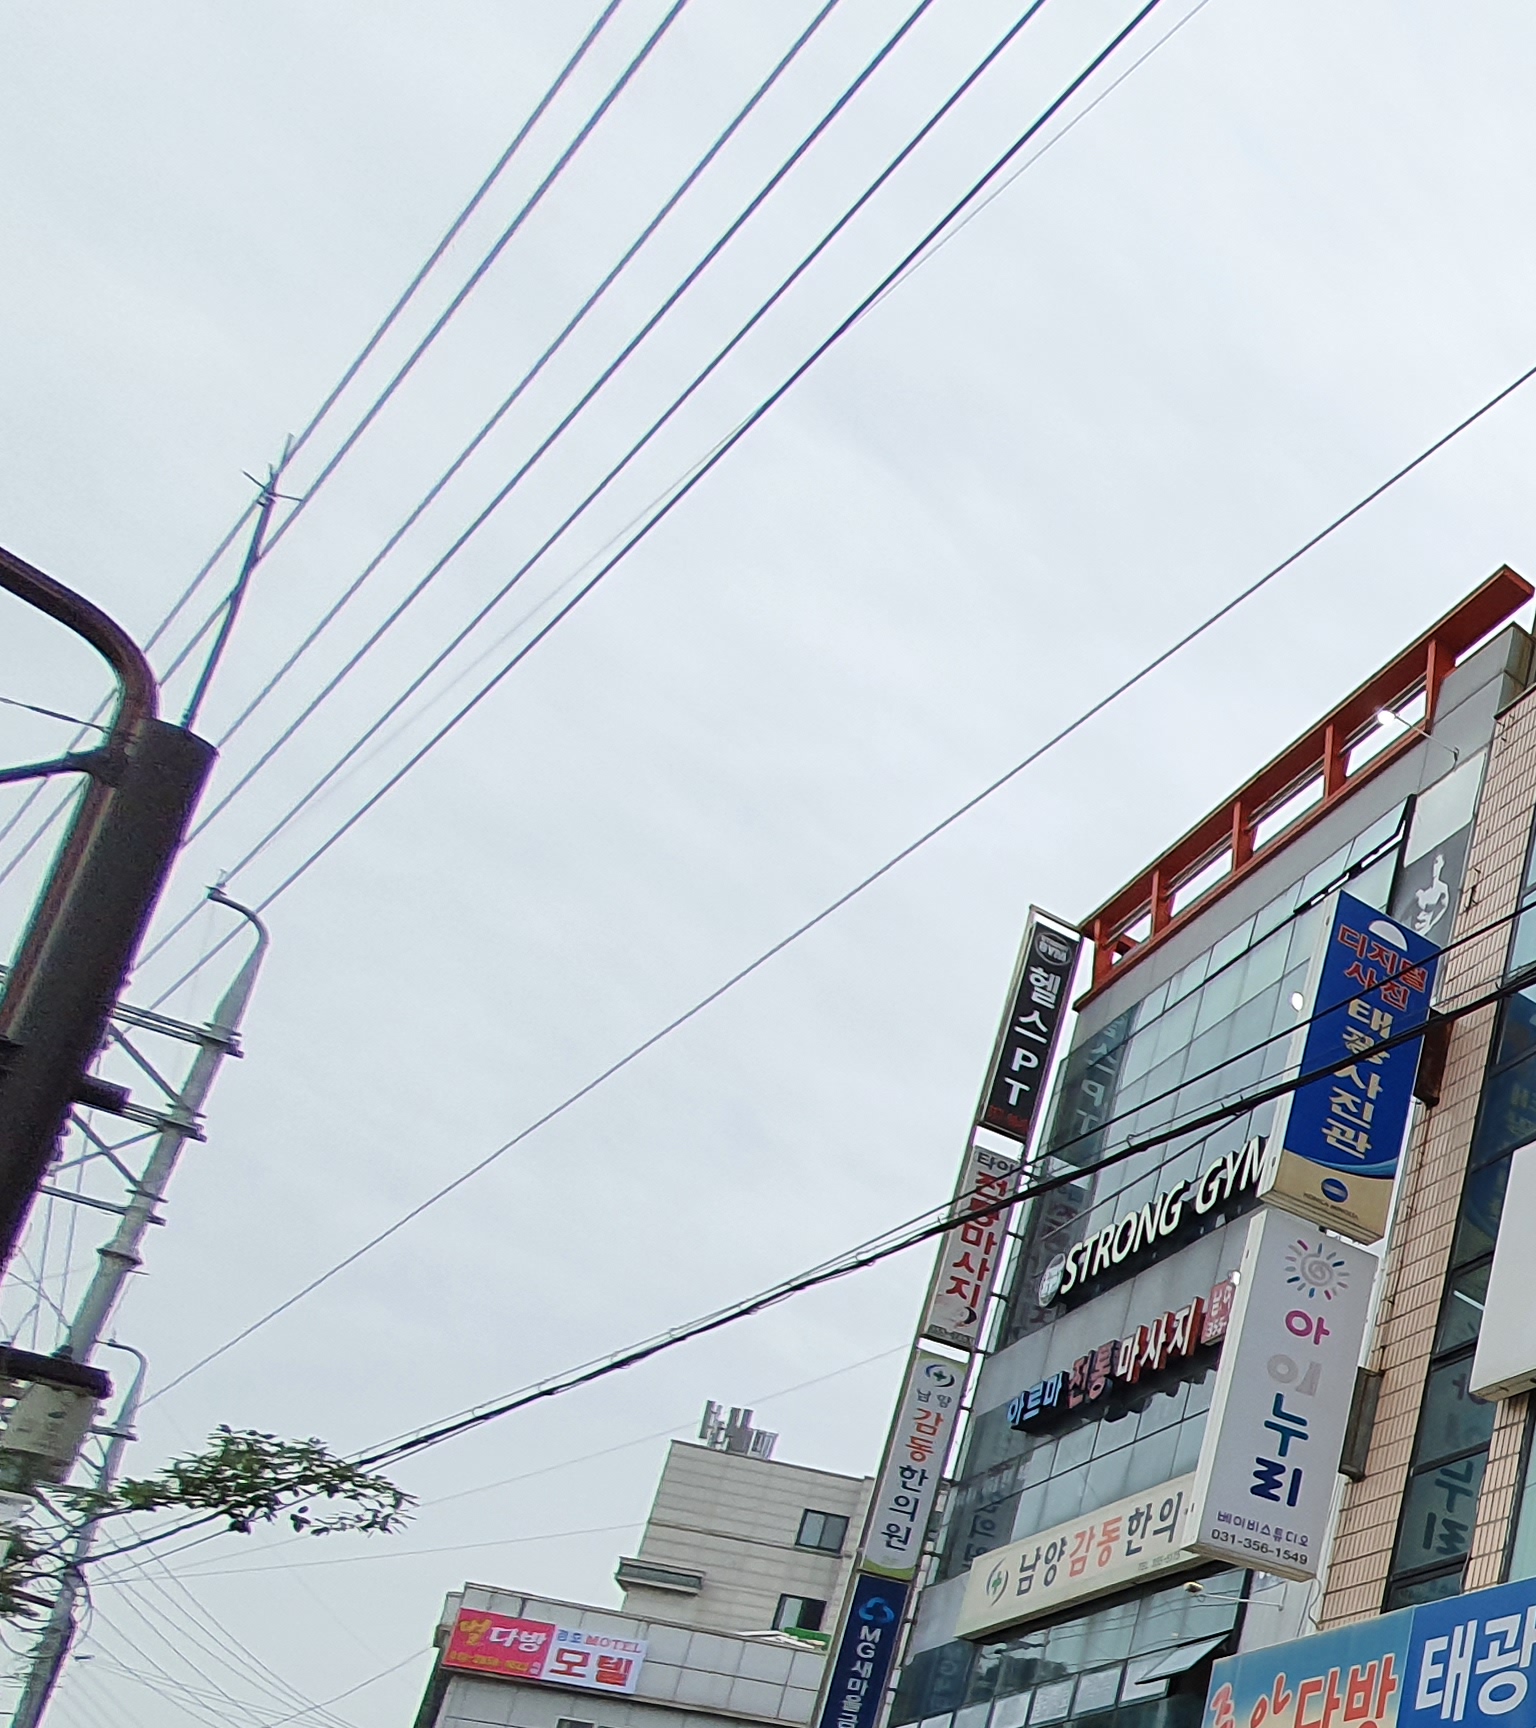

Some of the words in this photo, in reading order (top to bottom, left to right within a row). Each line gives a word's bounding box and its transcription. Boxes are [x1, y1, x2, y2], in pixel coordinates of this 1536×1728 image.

[1060, 1180, 1188, 1295] STRONG
[1211, 1529, 1308, 1566] 031-356-1549
[1217, 1511, 1309, 1547] 베이비스튜디오
[550, 1648, 634, 1687] 모텔
